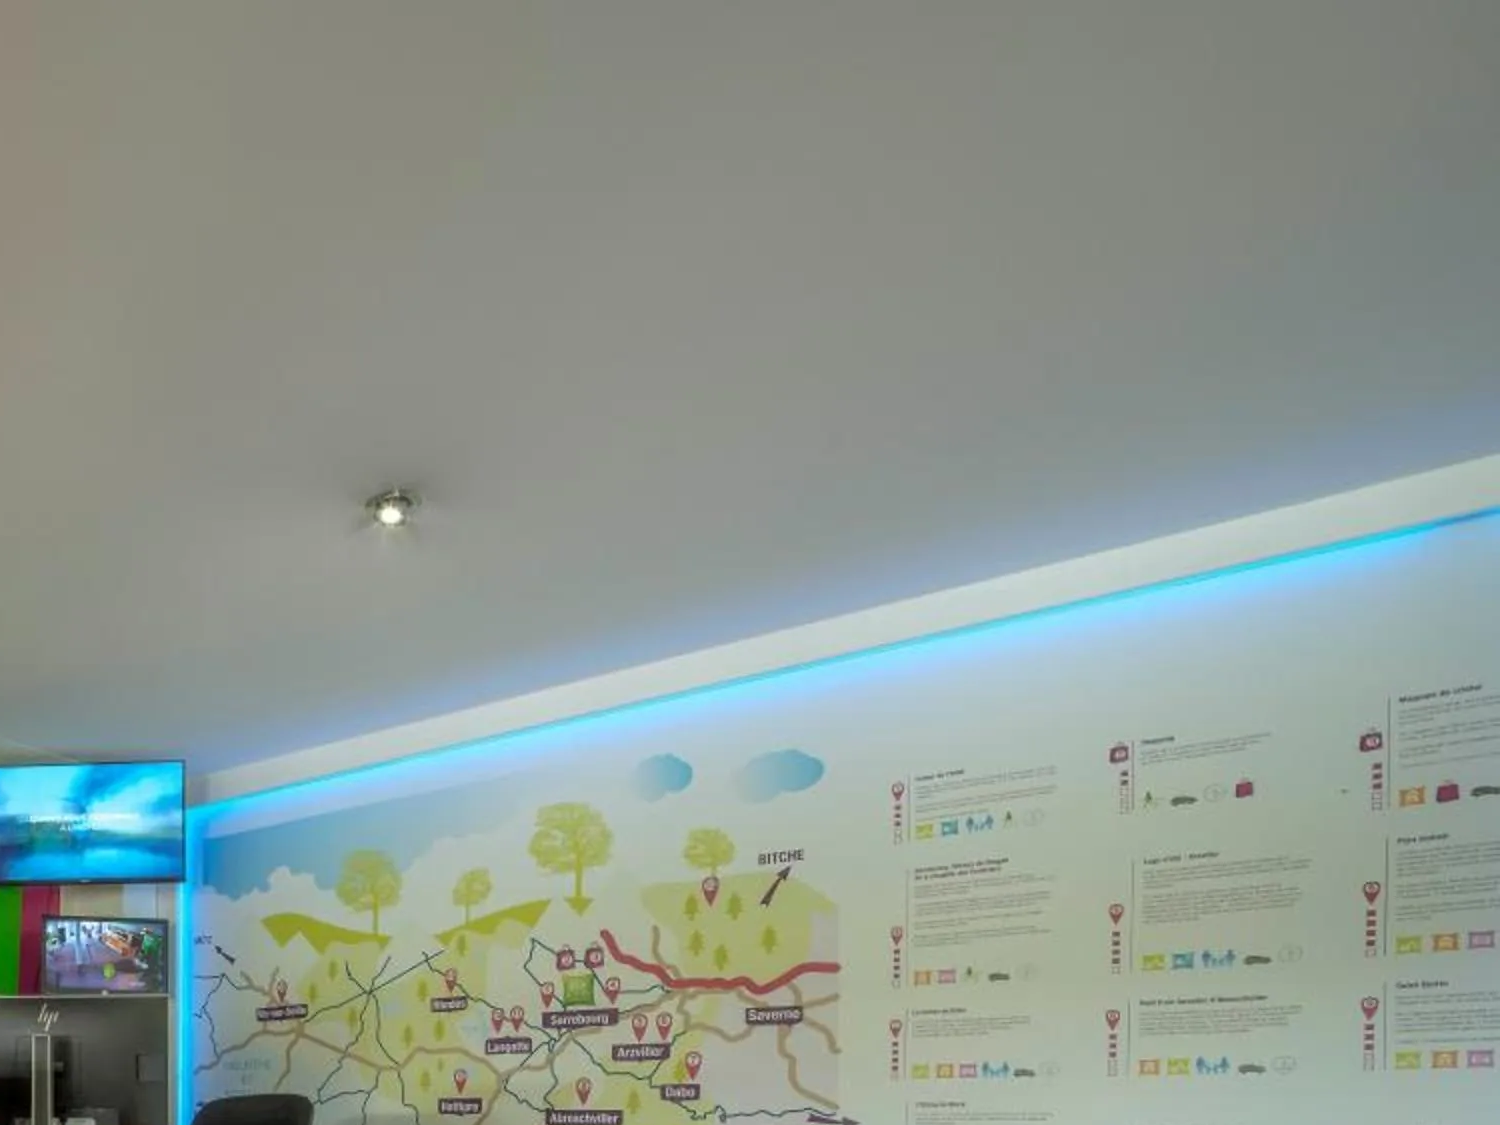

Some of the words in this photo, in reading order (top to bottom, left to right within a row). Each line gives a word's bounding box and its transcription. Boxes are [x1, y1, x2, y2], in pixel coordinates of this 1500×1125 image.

[757, 849, 805, 866] BITCHE
[37, 1003, 60, 1032] hp
[748, 1007, 801, 1022] Saverne
